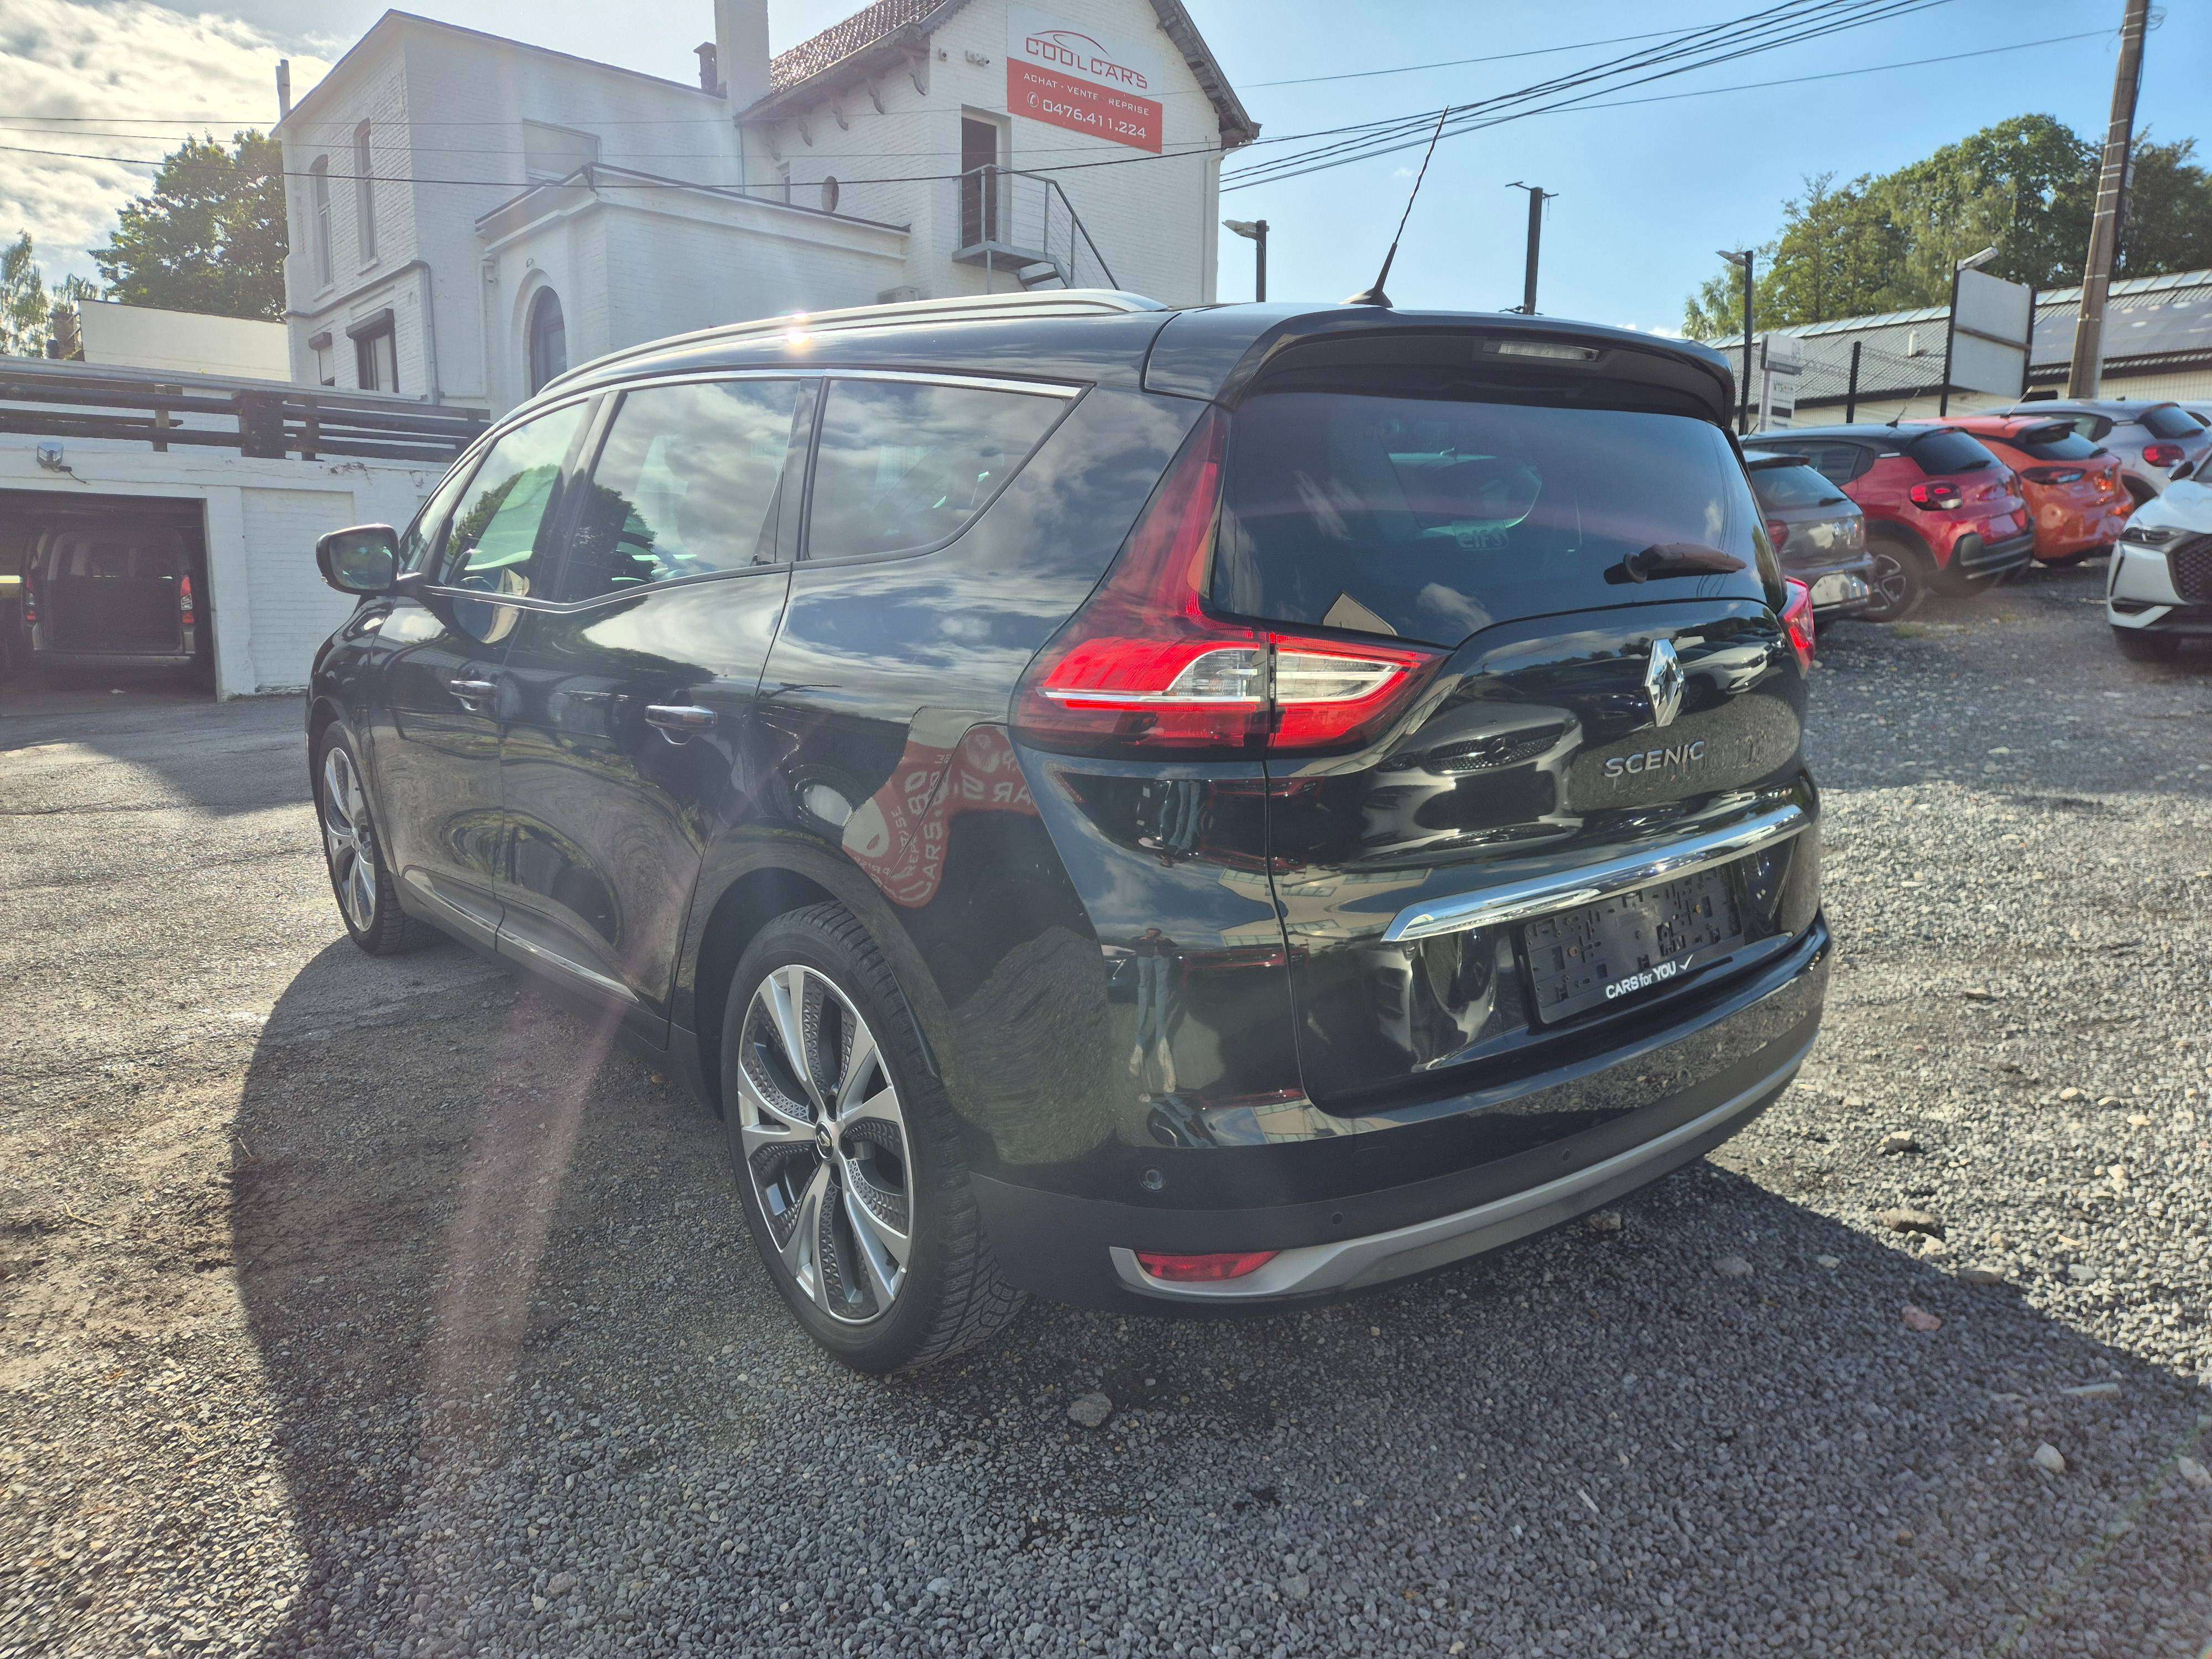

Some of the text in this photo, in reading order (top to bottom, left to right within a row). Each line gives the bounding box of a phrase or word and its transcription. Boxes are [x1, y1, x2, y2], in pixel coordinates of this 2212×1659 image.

[1024, 72, 1149, 116] ACHAT VENTE REPRISE
[1043, 98, 1146, 139] 0476.411.224
[1604, 740, 1705, 778] SCENIC
[1605, 960, 1677, 999] CARS for YOU
